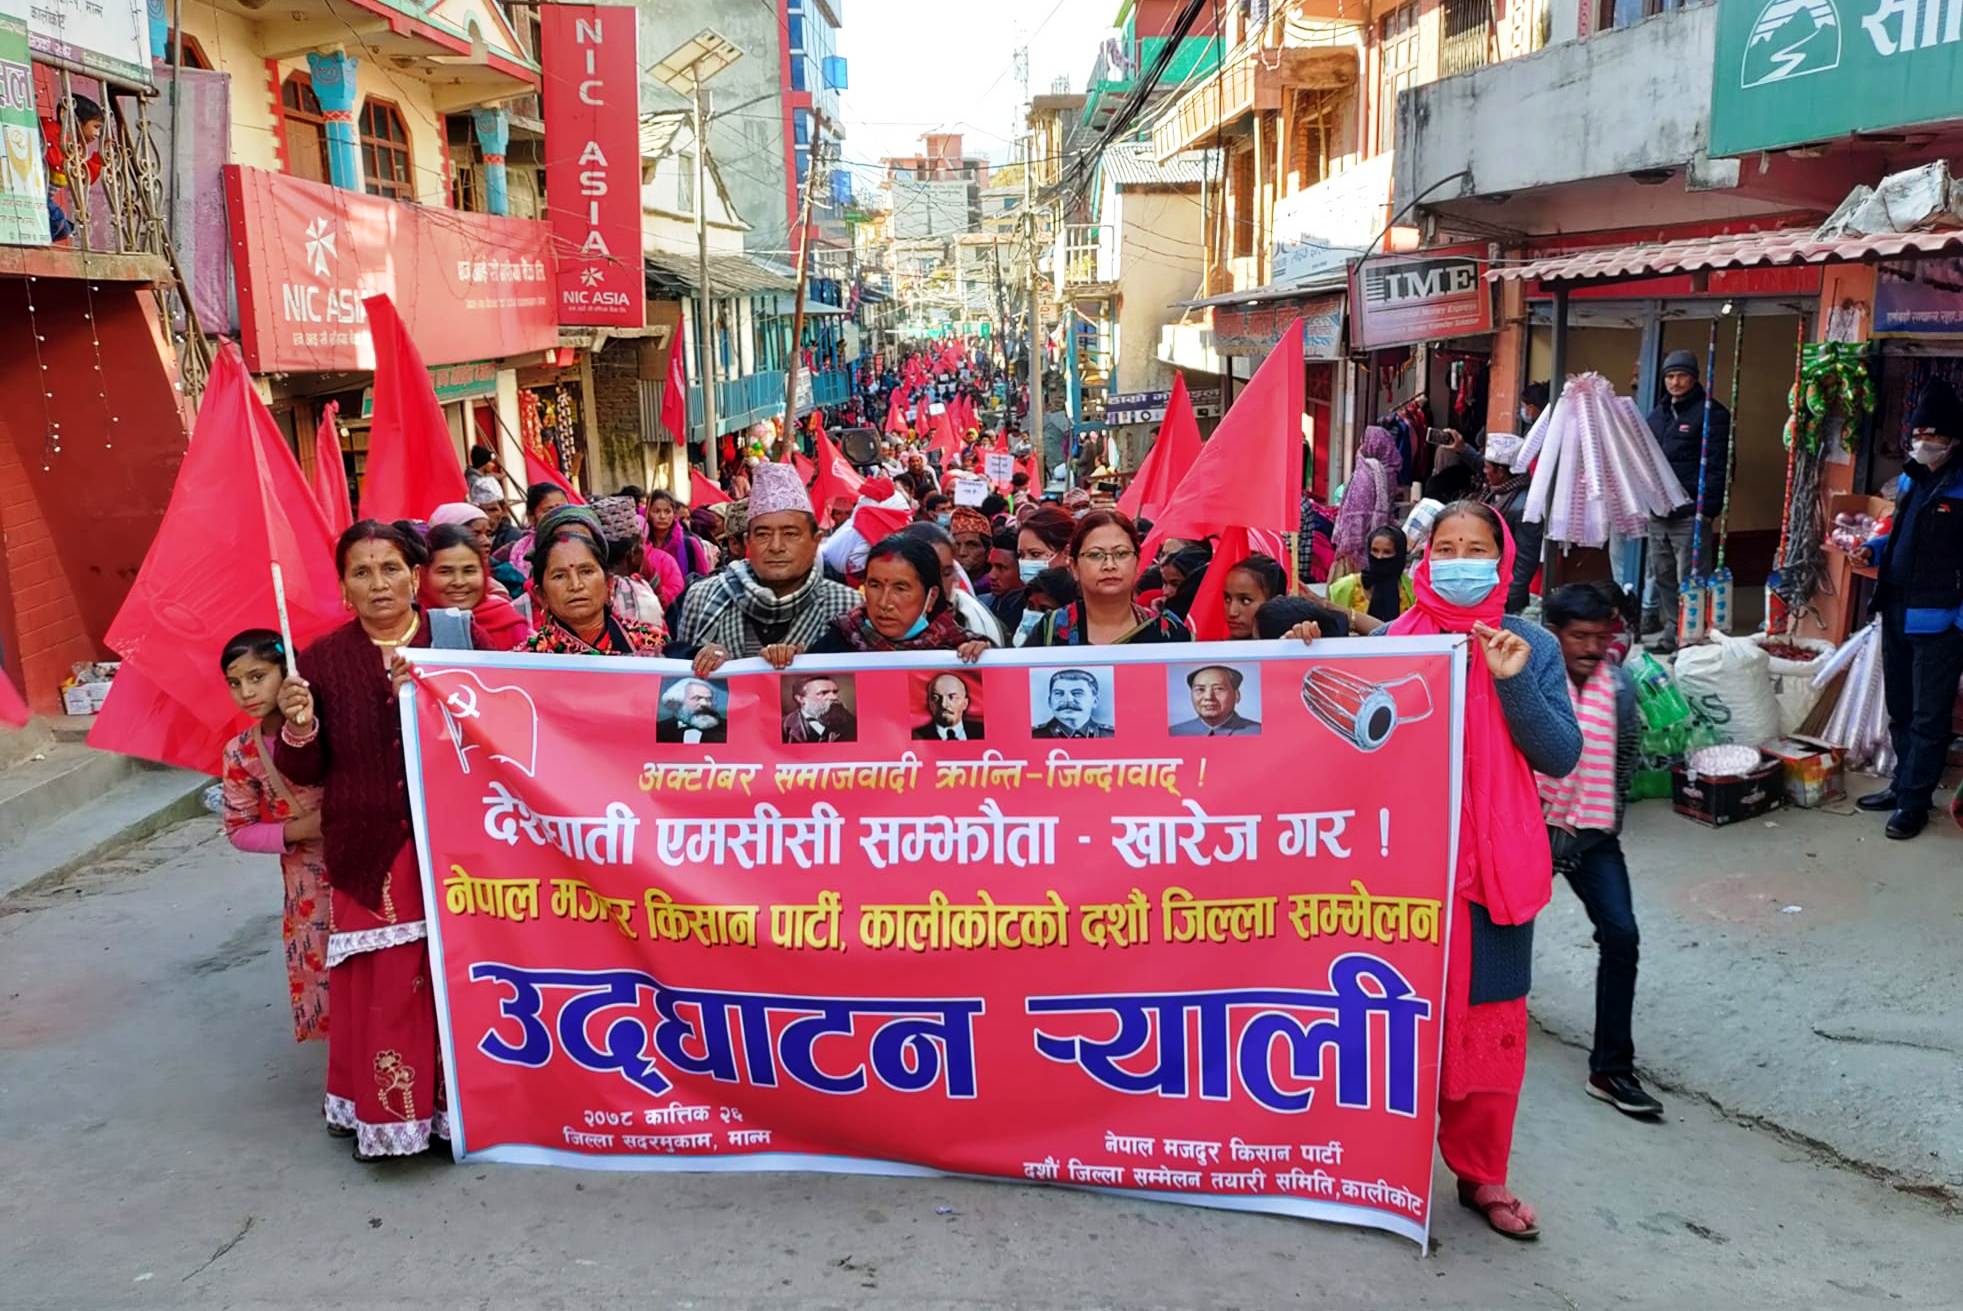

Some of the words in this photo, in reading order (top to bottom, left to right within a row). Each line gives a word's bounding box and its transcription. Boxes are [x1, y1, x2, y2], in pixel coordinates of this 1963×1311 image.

[575, 18, 604, 107] NIC
[577, 140, 610, 257] ASIA
[562, 290, 589, 304] NIC
[592, 291, 630, 306] ASIA
[1385, 264, 1477, 302] IME
[282, 283, 321, 322] NIC
[639, 755, 763, 796] अक्टोबर
[774, 751, 923, 794] समाजवादी
[656, 801, 846, 870] एमसीसी
[859, 798, 1059, 869] सम्झौता
[1111, 798, 1262, 868] खारेज
[1276, 809, 1356, 859] गर
[443, 865, 542, 922] नेपाल
[644, 888, 760, 948] किसान
[860, 889, 1070, 952] कालीकोटको
[1161, 886, 1279, 943] जिल्ला
[1287, 880, 1443, 946] सम्मेलन
[562, 1126, 614, 1148] जिल्ला
[584, 1109, 634, 1127] २०७८
[1104, 1130, 1155, 1157] नेपाल
[1163, 1138, 1221, 1166] मजदुर
[1230, 1137, 1292, 1164] किसान
[1300, 1140, 1344, 1165] पार्टी
[1068, 1157, 1125, 1184] जिल्ला
[1133, 1165, 1203, 1189] सम्मेलन
[1211, 1167, 1267, 1192] तयारी
